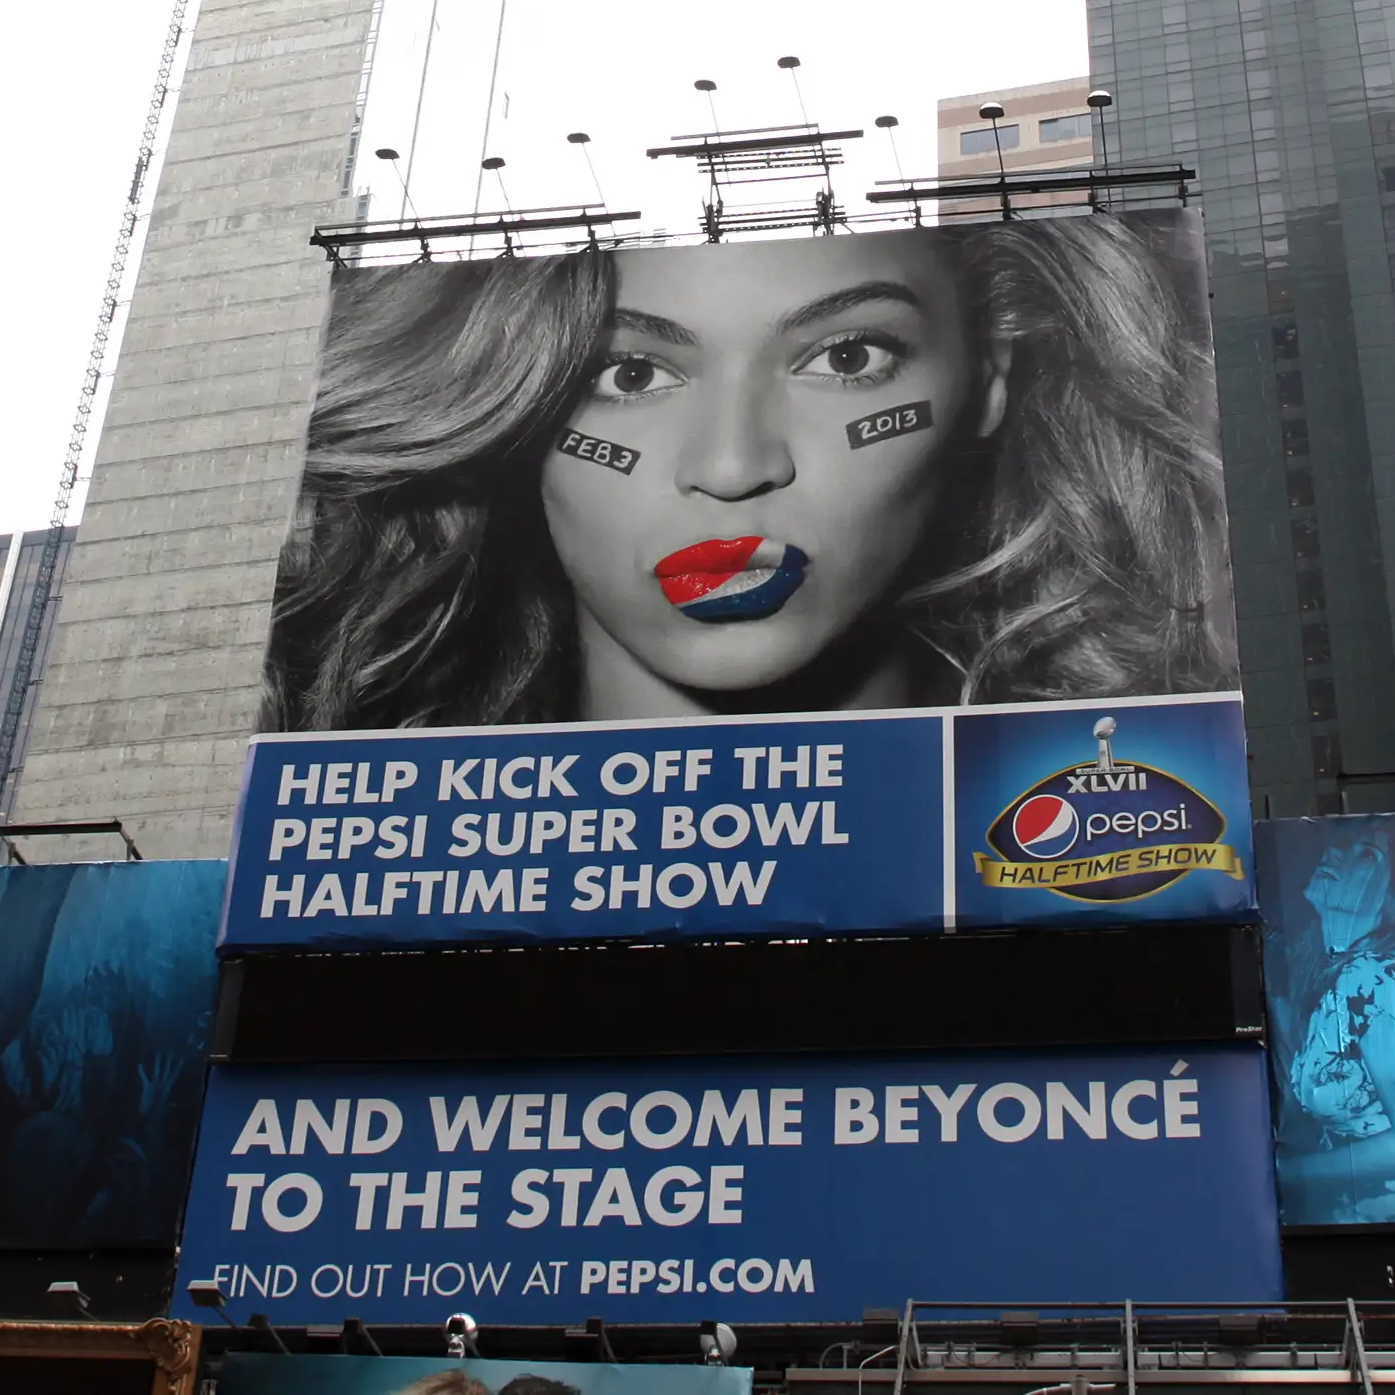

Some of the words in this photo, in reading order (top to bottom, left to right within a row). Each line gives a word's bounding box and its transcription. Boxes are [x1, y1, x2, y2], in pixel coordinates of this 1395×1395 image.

[858, 410, 918, 440] 2013
[562, 433, 612, 464] FEB
[612, 450, 633, 469] 3
[277, 761, 418, 805] HELP
[437, 754, 580, 801] KICK
[600, 749, 713, 795] OFF
[734, 744, 843, 789] THE
[1066, 772, 1147, 794] XLVII
[268, 815, 427, 861] PEPSI
[448, 808, 638, 857] SUPER
[661, 801, 850, 850] BOWL
[1086, 803, 1188, 841] pepsi
[999, 854, 1130, 884] HALFTIME
[1136, 847, 1217, 870] SHOW
[260, 868, 549, 918] HALFTIME
[570, 860, 777, 911] SHOW
[230, 1098, 403, 1155] AND
[431, 1088, 804, 1152] WELCOME
[833, 1059, 1201, 1145] BEYONCÉ
[225, 1172, 323, 1233] TO
[349, 1170, 482, 1230] THE
[506, 1165, 744, 1228] STAGE
[212, 1264, 298, 1298] FIND
[311, 1264, 393, 1298] OUT
[403, 1262, 511, 1297] HOW
[522, 1261, 569, 1295] AT
[580, 1258, 815, 1295] PEPSI.COM
